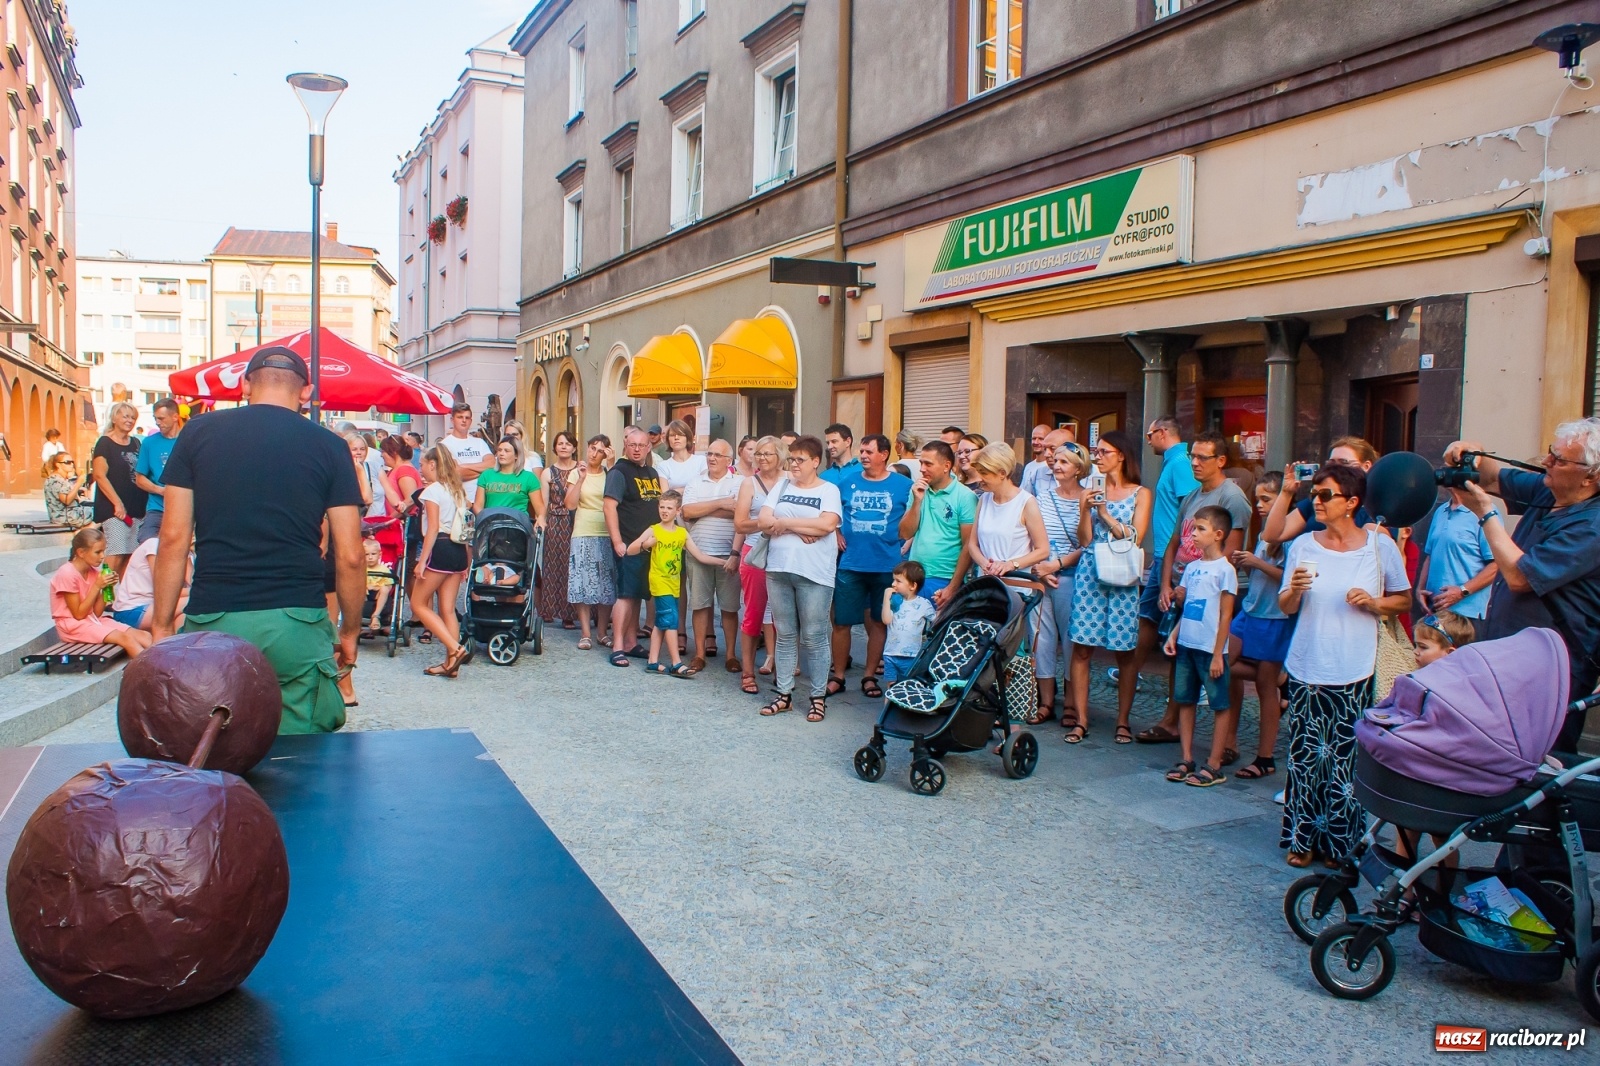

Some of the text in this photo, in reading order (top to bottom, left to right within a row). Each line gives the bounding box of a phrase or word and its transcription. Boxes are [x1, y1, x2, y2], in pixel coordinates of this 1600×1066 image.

[963, 192, 1092, 259] FUJIFILM
[1126, 205, 1170, 228] STUDIO
[1113, 222, 1174, 247] CYFR@FOTO
[1108, 243, 1174, 263] www.fotokaminski.pl
[942, 245, 1102, 289] LABORATORIUM FOTOGRAFICZNE
